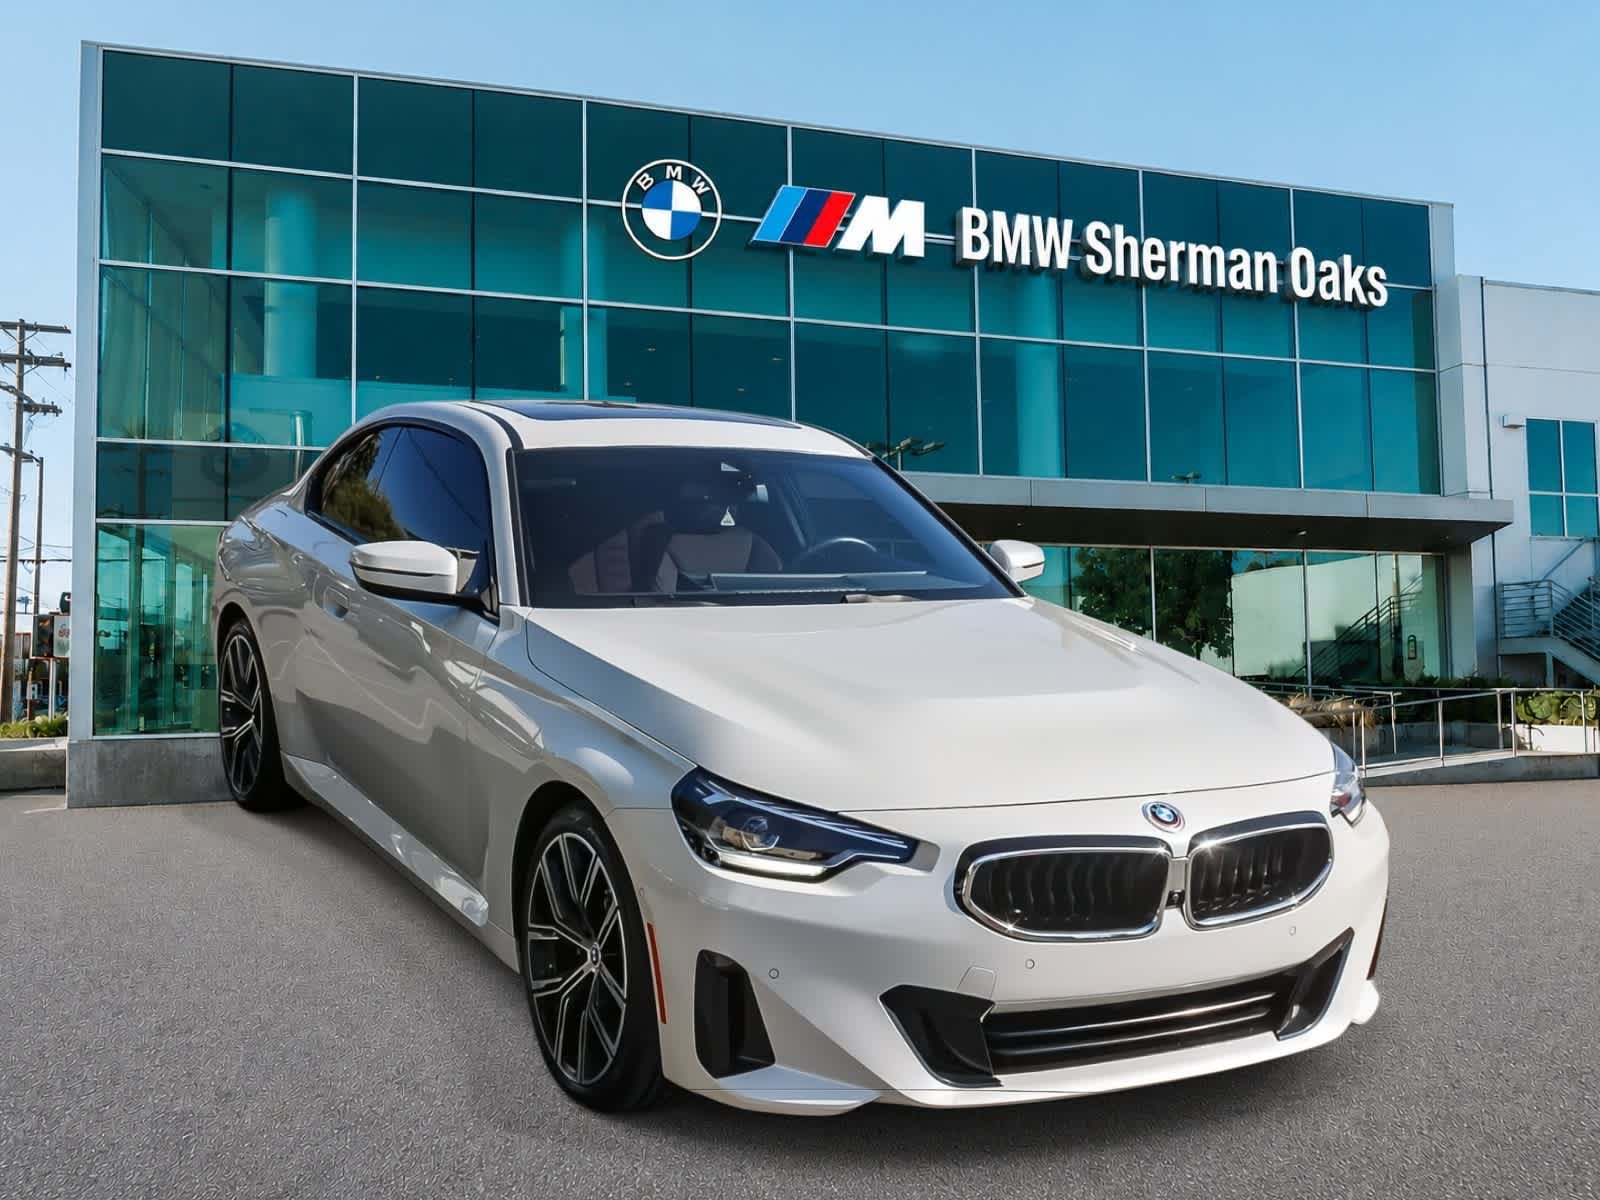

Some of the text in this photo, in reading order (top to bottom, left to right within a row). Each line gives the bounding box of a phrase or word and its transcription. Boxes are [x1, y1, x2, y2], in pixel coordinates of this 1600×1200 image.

[636, 165, 711, 195] BMW
[836, 195, 925, 258] M
[959, 206, 1388, 308] BMW Sherman Oaks
